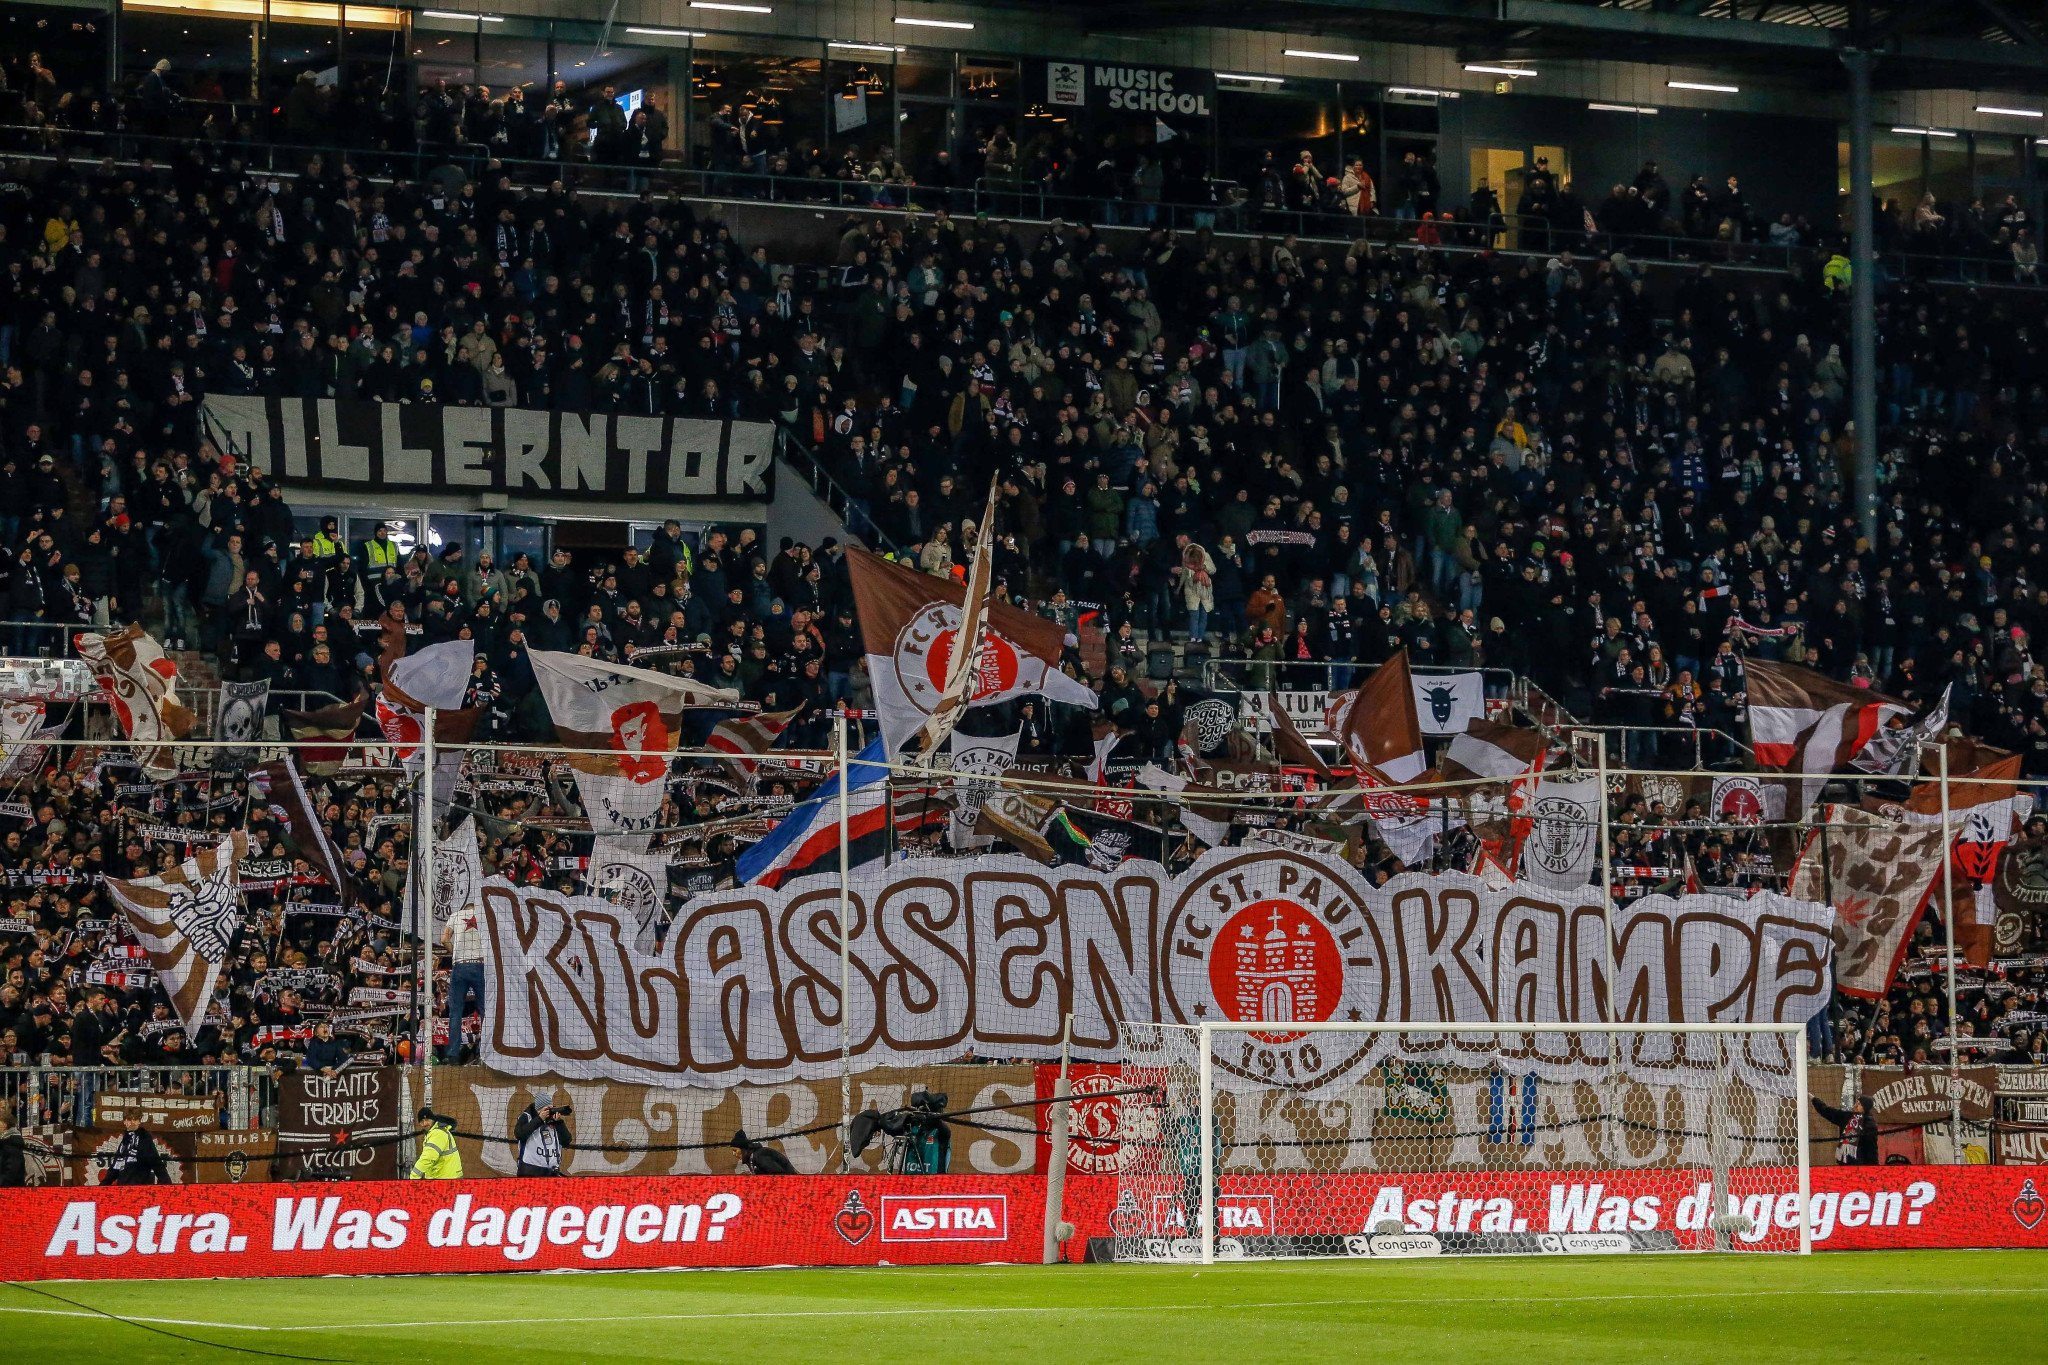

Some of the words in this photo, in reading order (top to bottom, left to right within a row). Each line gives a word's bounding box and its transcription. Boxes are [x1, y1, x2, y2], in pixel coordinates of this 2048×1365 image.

[1095, 66, 1174, 92] MUSIC
[1109, 88, 1210, 115] SCHOOL
[204, 393, 776, 495] MILLERNTOR
[904, 628, 930, 655] FC
[2, 804, 31, 815] PAULI
[33, 868, 75, 876] PAULI
[1543, 857, 1569, 871] 1910
[1177, 916, 1212, 960] FC
[1211, 880, 1261, 914] ST.
[1278, 869, 1372, 968] PAULI
[482, 872, 1160, 1073] KLASSEN
[1393, 888, 1830, 1075] KAMPF
[1241, 1042, 1322, 1079] 1910
[303, 1072, 380, 1098] ENFANTS
[1872, 1076, 1929, 1114] WILDER
[300, 1100, 380, 1126] TERRIBLES
[1902, 1100, 1934, 1114] SANKT
[201, 1130, 271, 1145] SMILEY
[302, 1146, 375, 1168] VECCHIO
[892, 1208, 996, 1231] ASTRA
[1364, 1186, 1529, 1233] Astra.
[1548, 1183, 1661, 1232] Was
[45, 1201, 248, 1256] Astra.
[272, 1195, 410, 1252] Was
[427, 1192, 743, 1262] dagegen?
[1377, 1240, 1435, 1256] congstar
[1570, 1238, 1628, 1254] congstar
